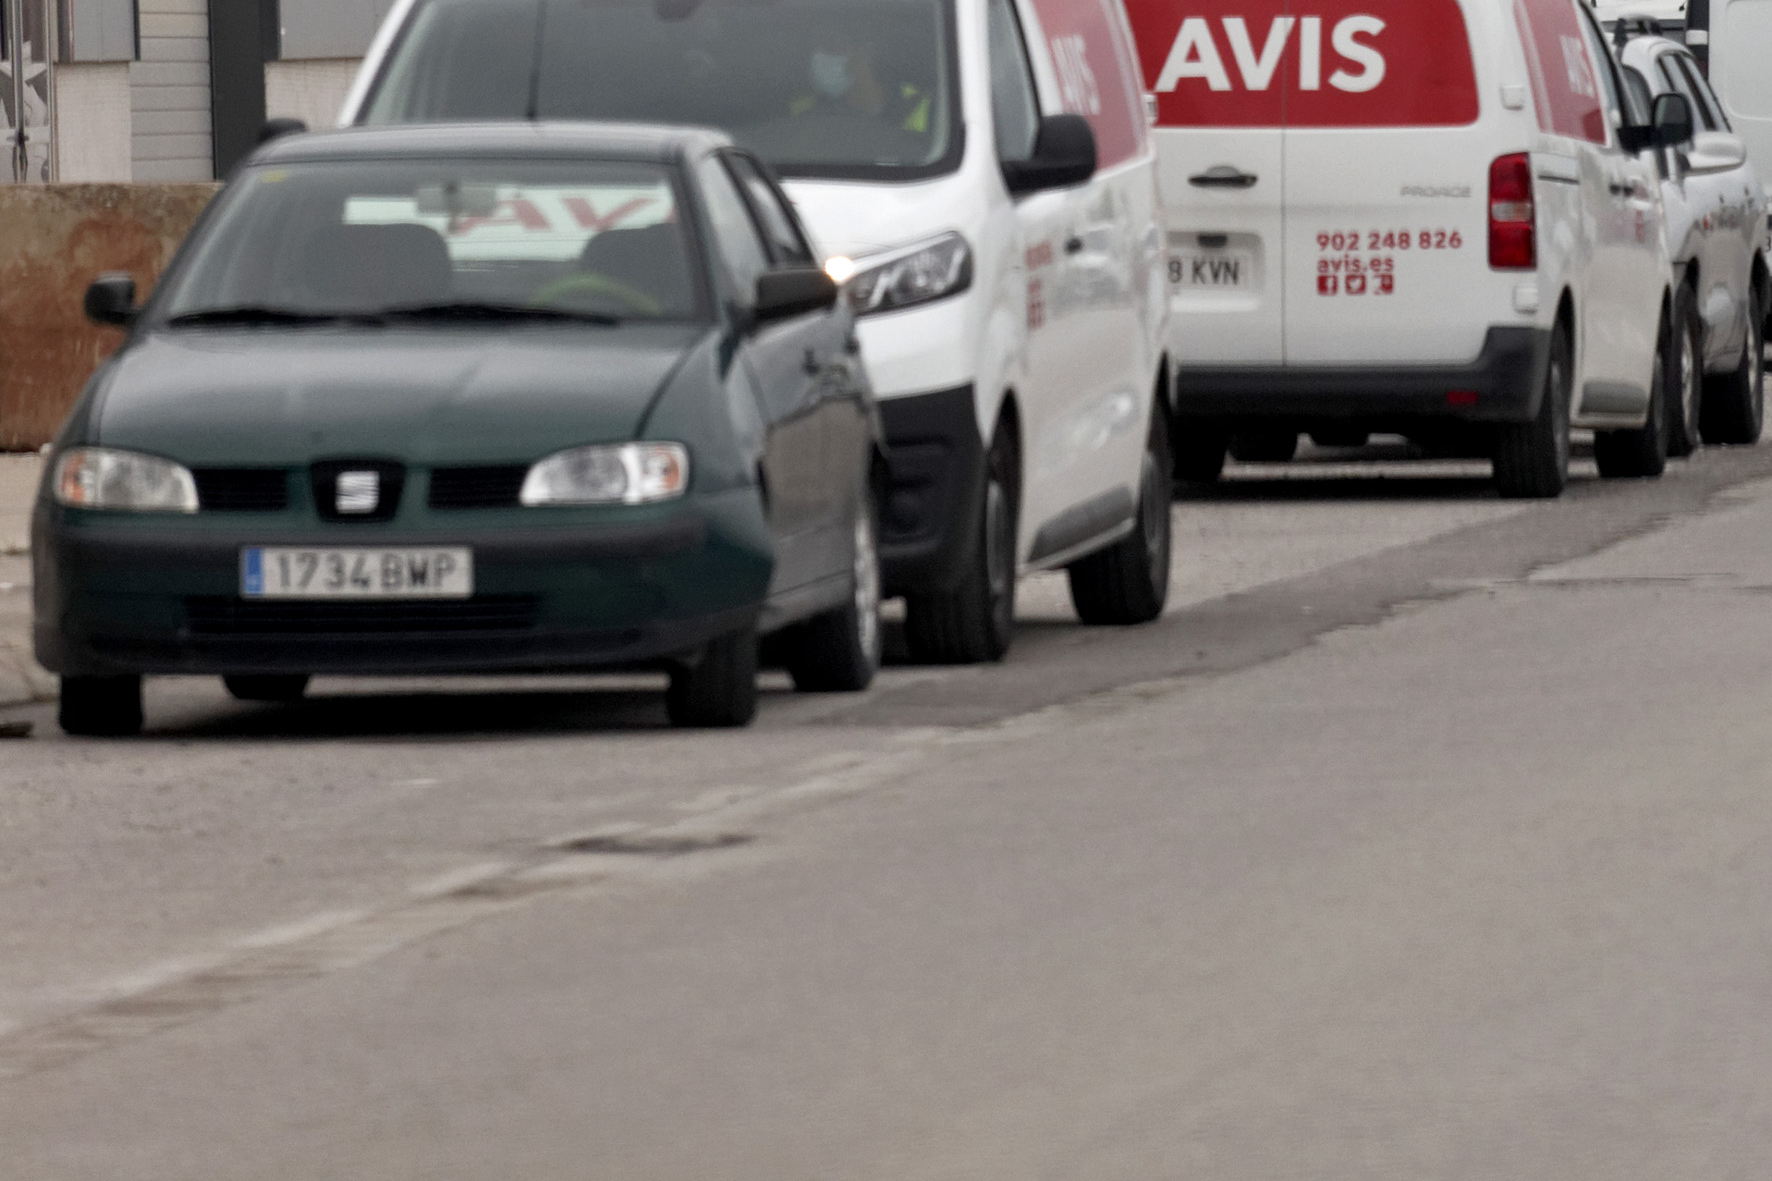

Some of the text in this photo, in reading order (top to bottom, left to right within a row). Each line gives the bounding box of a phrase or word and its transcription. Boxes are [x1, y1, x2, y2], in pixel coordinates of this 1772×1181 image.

[1154, 13, 1387, 93] AVIS
[1316, 229, 1463, 251] 902 248 826
[1191, 259, 1240, 285] KVN
[1317, 253, 1395, 273] avis.es
[278, 551, 455, 589] 1734 BWP
